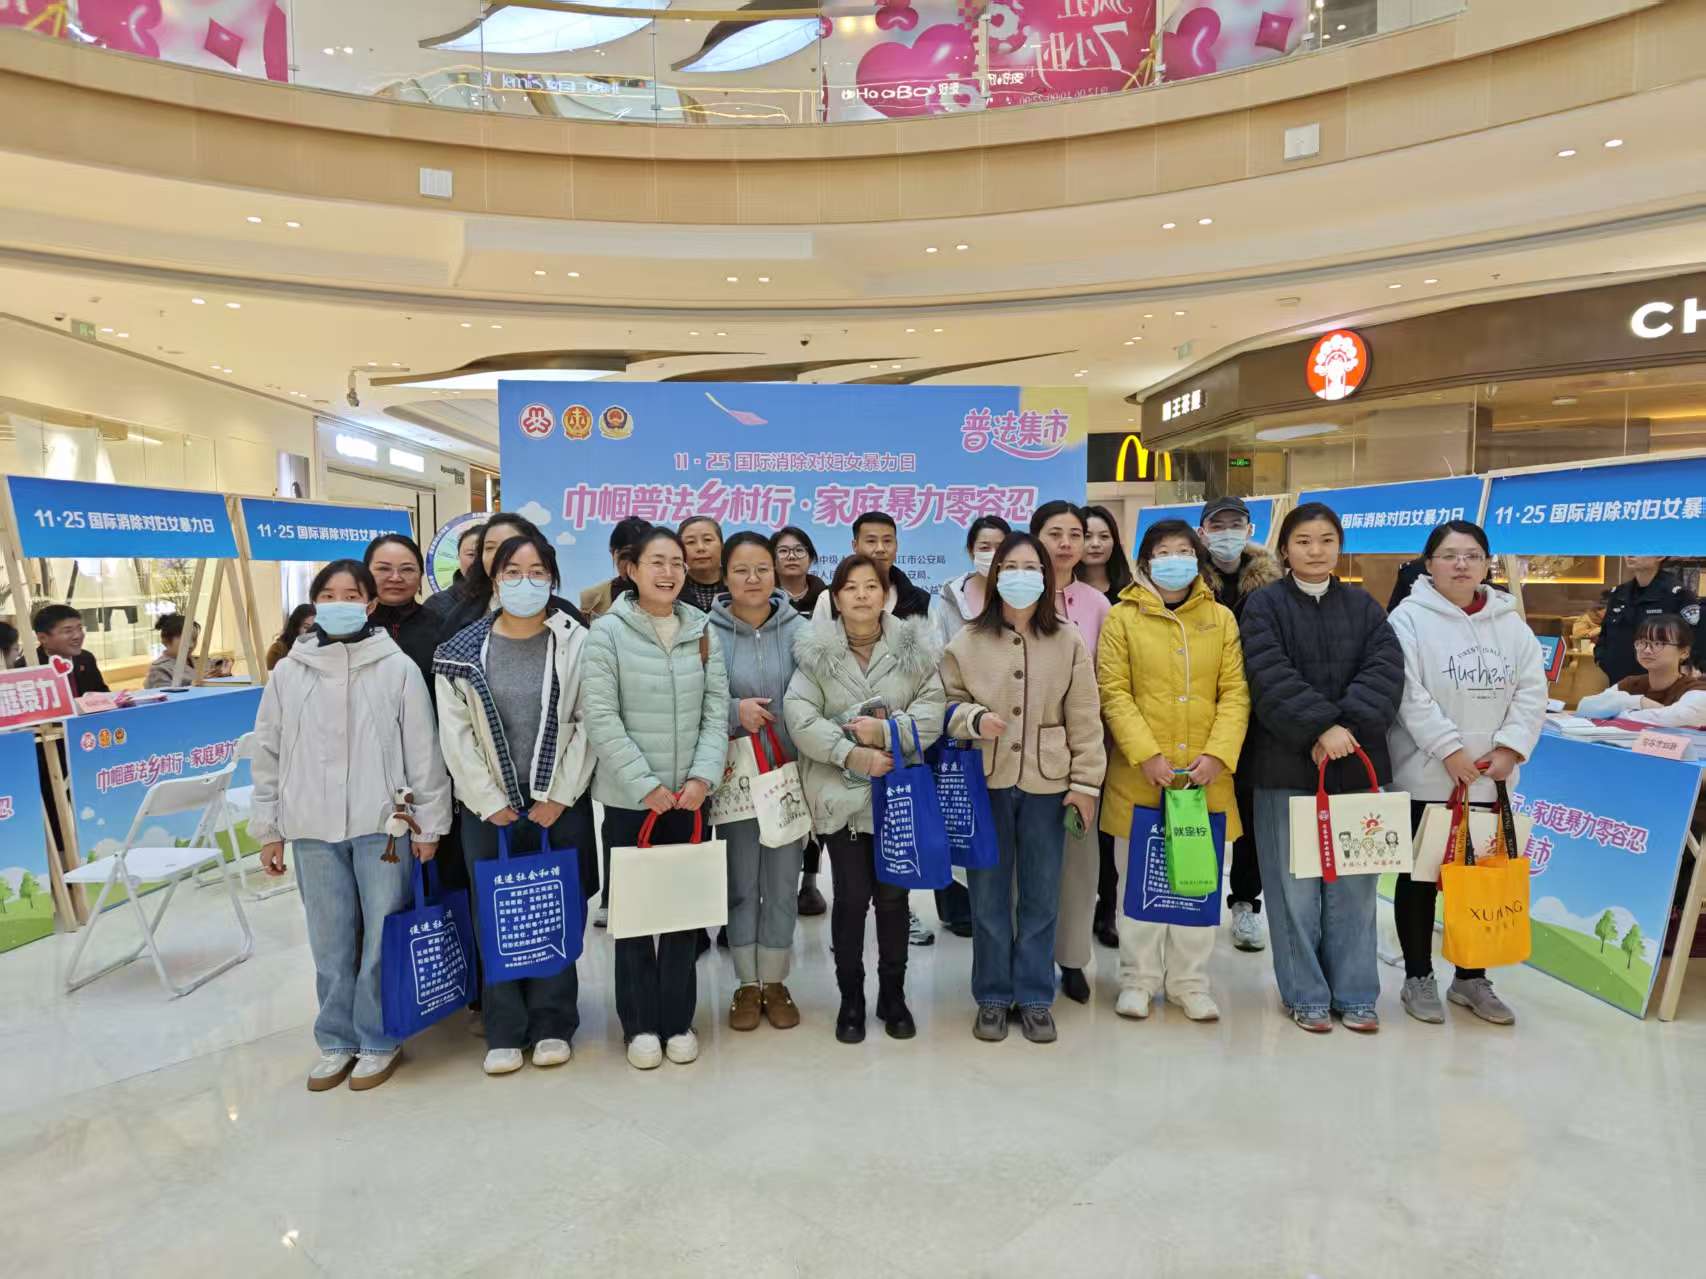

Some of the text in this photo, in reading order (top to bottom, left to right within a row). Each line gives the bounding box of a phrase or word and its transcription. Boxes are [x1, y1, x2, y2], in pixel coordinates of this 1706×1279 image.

[1162, 389, 1201, 422] 王茶
[960, 407, 1068, 453] 普法集市
[734, 452, 917, 473] 国际消除对妇女暴力日
[88, 512, 215, 533] 国际消除对妇女暴力日
[1550, 496, 1706, 523] 国际消除对妇女暴
